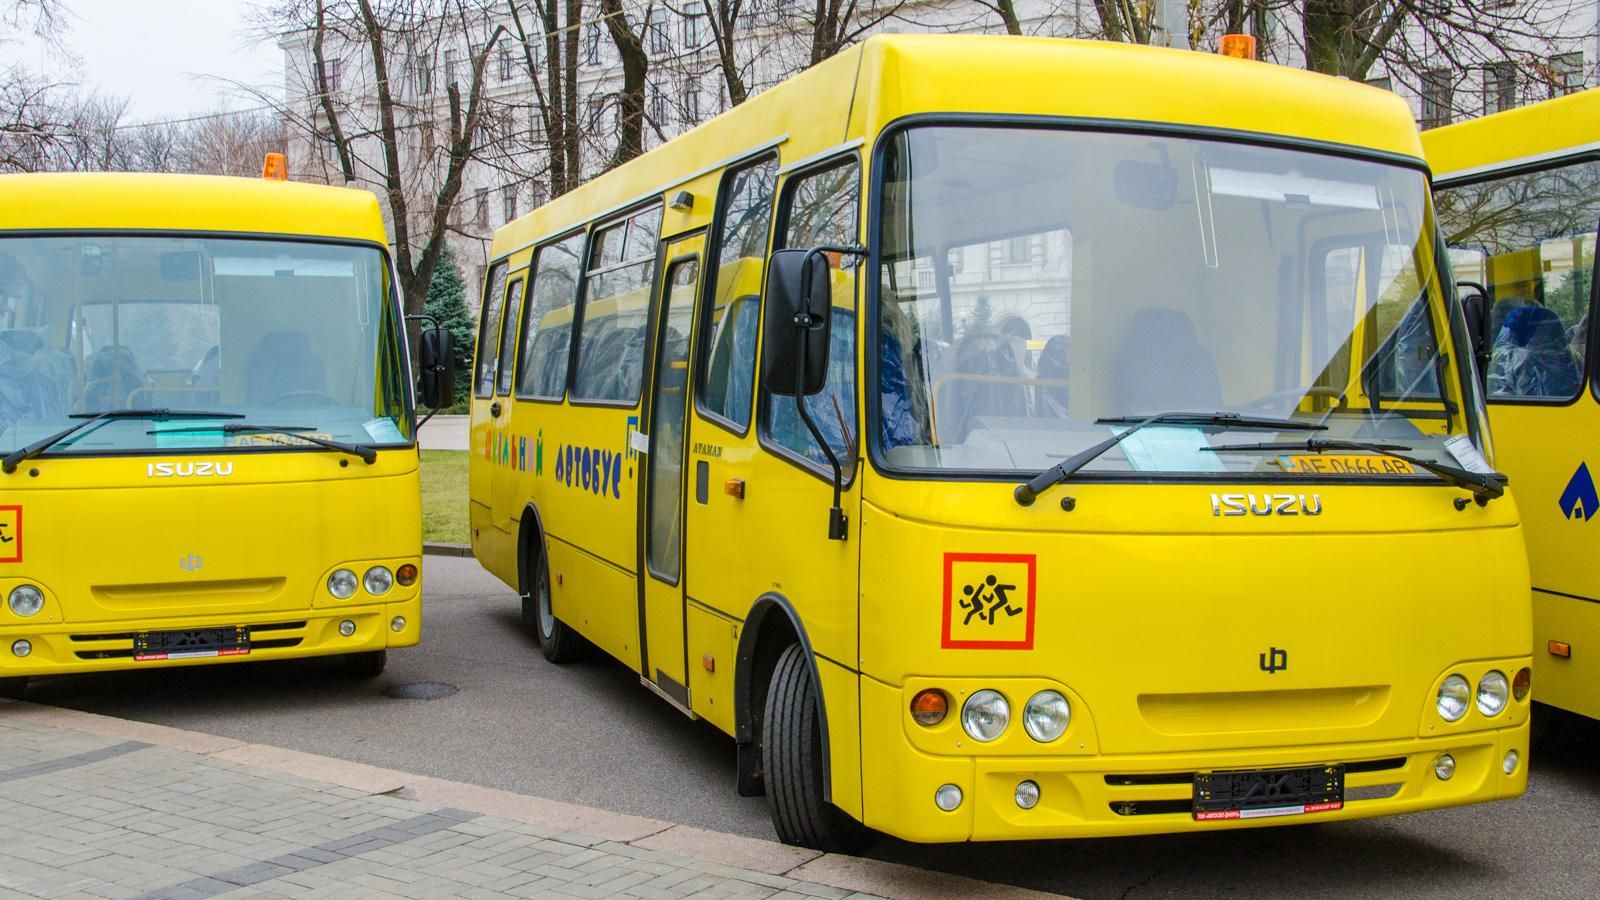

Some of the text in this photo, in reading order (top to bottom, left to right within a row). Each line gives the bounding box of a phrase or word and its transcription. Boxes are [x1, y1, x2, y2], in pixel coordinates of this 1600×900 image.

[147, 462, 234, 477] ISUZU
[555, 444, 622, 499] АВТОБУС
[1210, 493, 1323, 516] ISUZU
